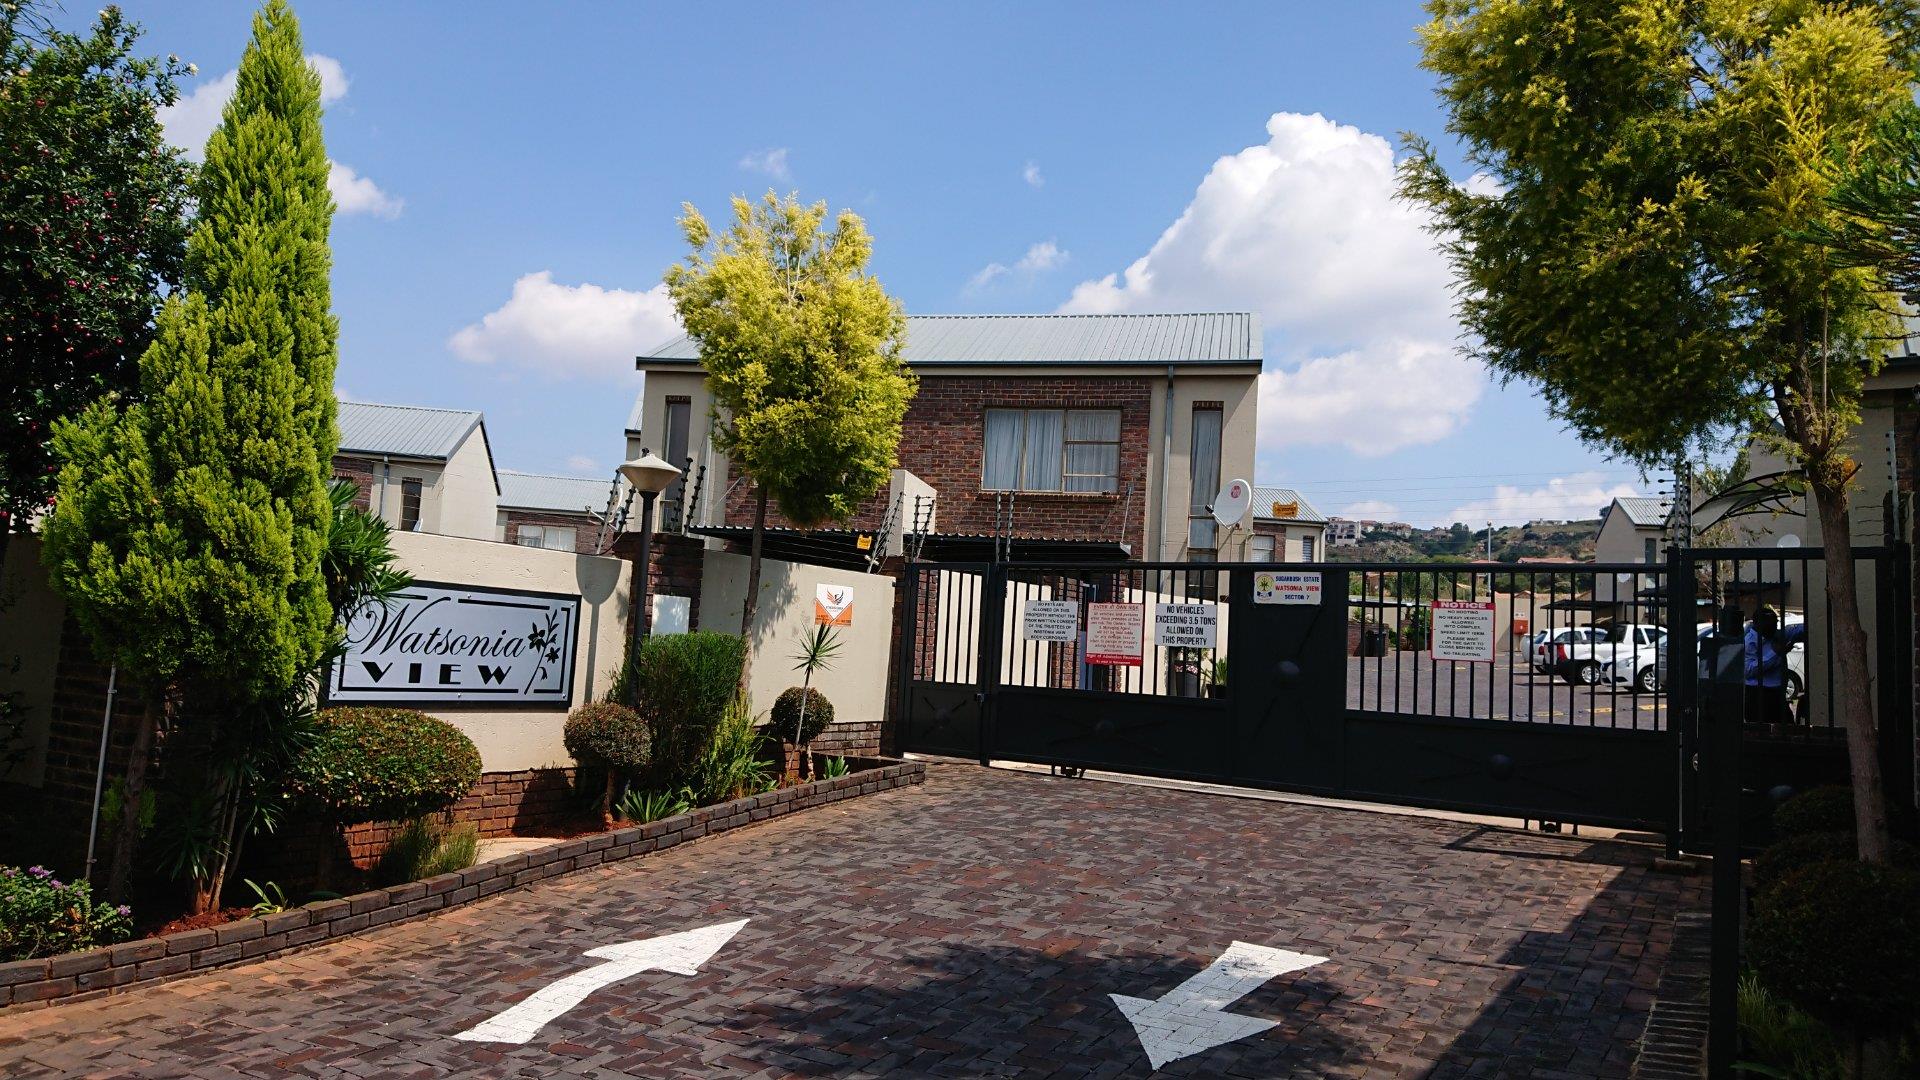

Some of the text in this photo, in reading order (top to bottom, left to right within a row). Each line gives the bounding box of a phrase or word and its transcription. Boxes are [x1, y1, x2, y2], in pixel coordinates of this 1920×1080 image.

[1176, 606, 1204, 614] VEHICLES
[1156, 615, 1188, 624] EXCEEDING
[1200, 617, 1216, 625] TONS
[345, 597, 526, 658] Watsonia
[1166, 626, 1203, 635] ALLOWED ON
[1162, 636, 1207, 645] THIS PROPERTY
[361, 661, 512, 686] VIEW
